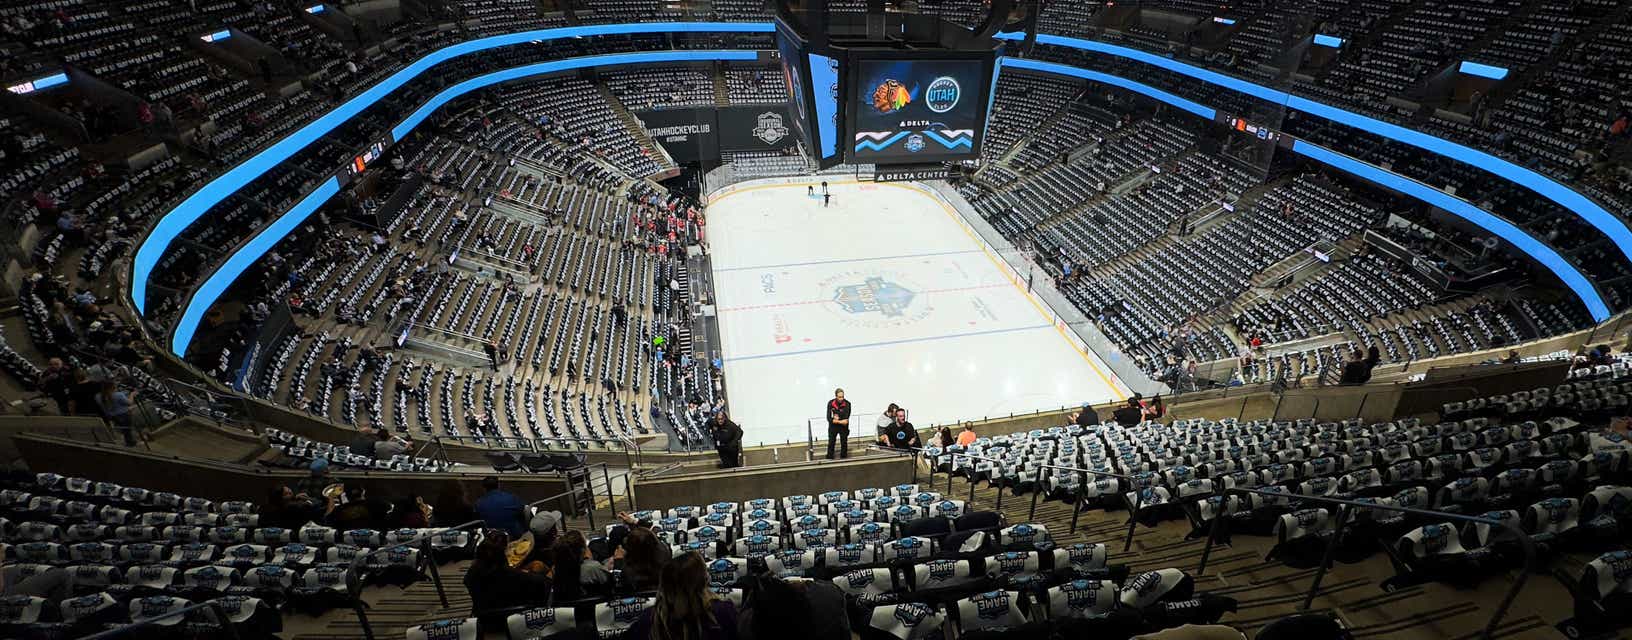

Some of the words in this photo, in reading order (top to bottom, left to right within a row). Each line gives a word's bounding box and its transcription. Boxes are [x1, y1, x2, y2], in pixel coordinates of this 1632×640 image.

[929, 88, 956, 102] UTAH
[930, 563, 954, 573] GAME
[1001, 559, 1025, 569] GAME
[848, 568, 873, 582] GAME
[1068, 589, 1097, 601] GAME
[615, 603, 641, 615] GAME
[897, 602, 927, 618] GAME
[978, 598, 1009, 610] GAME
[526, 607, 554, 620] GAME
[427, 624, 457, 636] GAME
